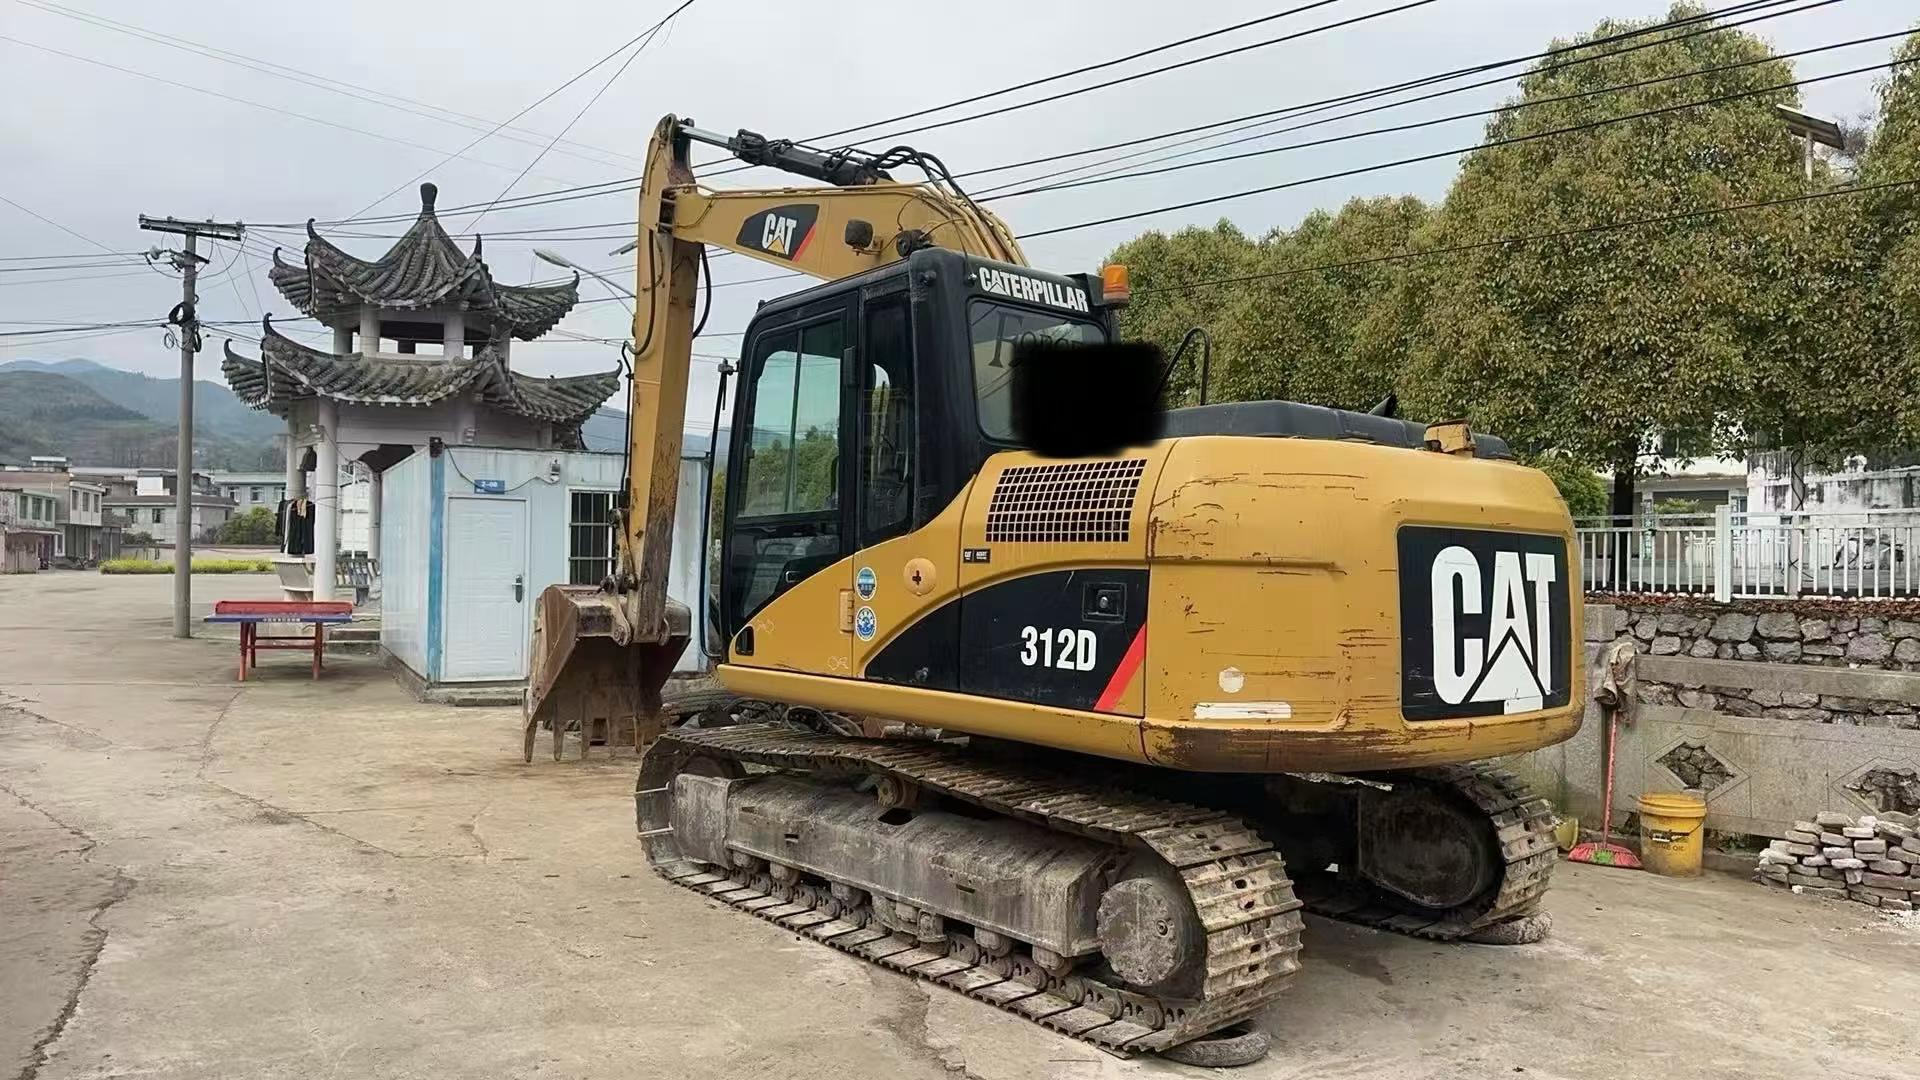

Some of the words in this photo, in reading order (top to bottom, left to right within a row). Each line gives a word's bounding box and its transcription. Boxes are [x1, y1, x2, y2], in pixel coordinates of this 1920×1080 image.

[762, 213, 797, 255] CAT
[979, 266, 1089, 313] CATERPILLAR
[1431, 545, 1556, 704] CAT
[1020, 625, 1097, 672] 312D
